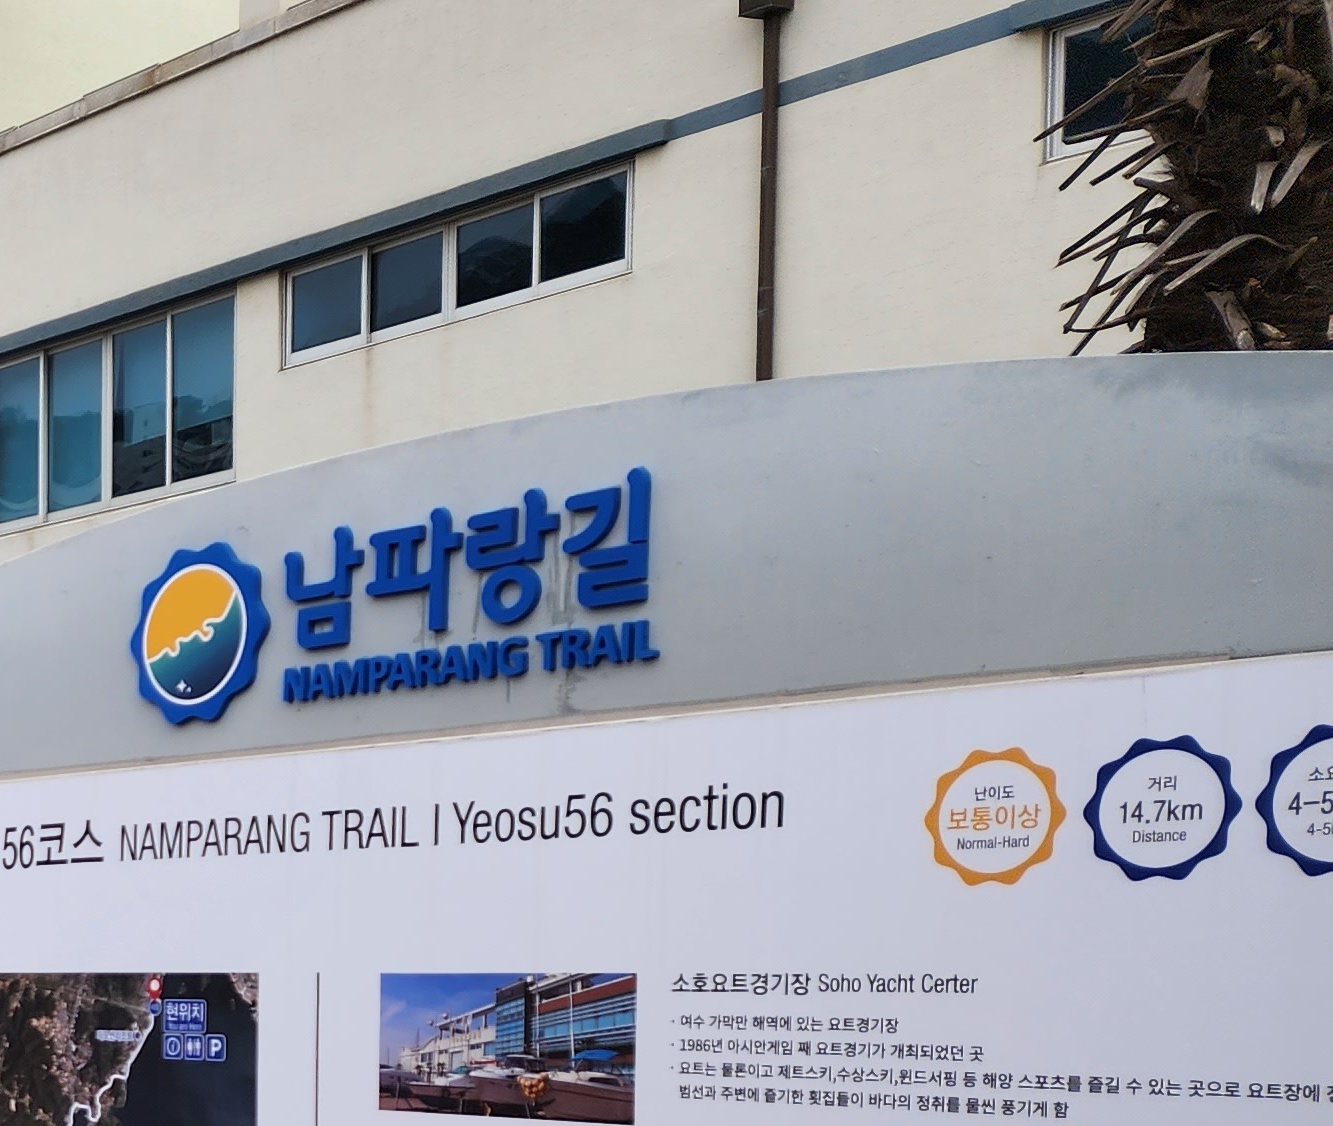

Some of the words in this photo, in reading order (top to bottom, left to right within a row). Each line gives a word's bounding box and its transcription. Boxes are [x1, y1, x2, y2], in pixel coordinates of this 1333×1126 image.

[282, 466, 652, 649] 남파랑길
[282, 634, 530, 704] NAMPARANG
[536, 619, 661, 674] TRAIL
[973, 783, 1016, 801] 난이도
[1146, 774, 1179, 793] 거리
[946, 803, 1042, 832] 보통이상
[1118, 799, 1204, 827] 14.7km
[1, 819, 105, 871] 56코스
[118, 811, 311, 863] NAMPARANG
[321, 805, 420, 852] TRAIL
[451, 791, 614, 845] Yeosu56
[628, 782, 785, 836] section
[1131, 827, 1188, 846] Distance
[955, 833, 1031, 853] Normal-Hard
[670, 972, 812, 995] 소호요트경기장
[817, 972, 862, 993] Soho
[866, 973, 916, 994] Yacht
[166, 1002, 204, 1022] 현위치
[680, 1013, 706, 1031] 여수
[708, 1013, 748, 1031] 가막만
[751, 1015, 792, 1033] 해역에
[796, 1015, 824, 1033] 있는
[827, 1016, 900, 1035] 요트경기장
[679, 1037, 723, 1054] 1986년
[727, 1038, 793, 1056] 아시안게임
[814, 1041, 887, 1060] 요트경기가
[889, 1042, 964, 1062] 개최되었던
[678, 1061, 718, 1077] 요트는
[982, 1071, 1014, 1090] 해양
[1016, 1073, 1083, 1093] 스포츠를
[1087, 1075, 1120, 1095] 즐길
[1148, 1077, 1183, 1097] 있는
[1187, 1079, 1242, 1098] 곳으로
[1246, 1082, 1321, 1104] 요트장에
[720, 1085, 760, 1103] 주변에
[808, 1089, 864, 1109] 횟집들이
[868, 1091, 911, 1112] 바다의
[916, 1094, 961, 1114] 정취를
[965, 1097, 996, 1116] 물씬
[1000, 1098, 1048, 1119] 풍기게
